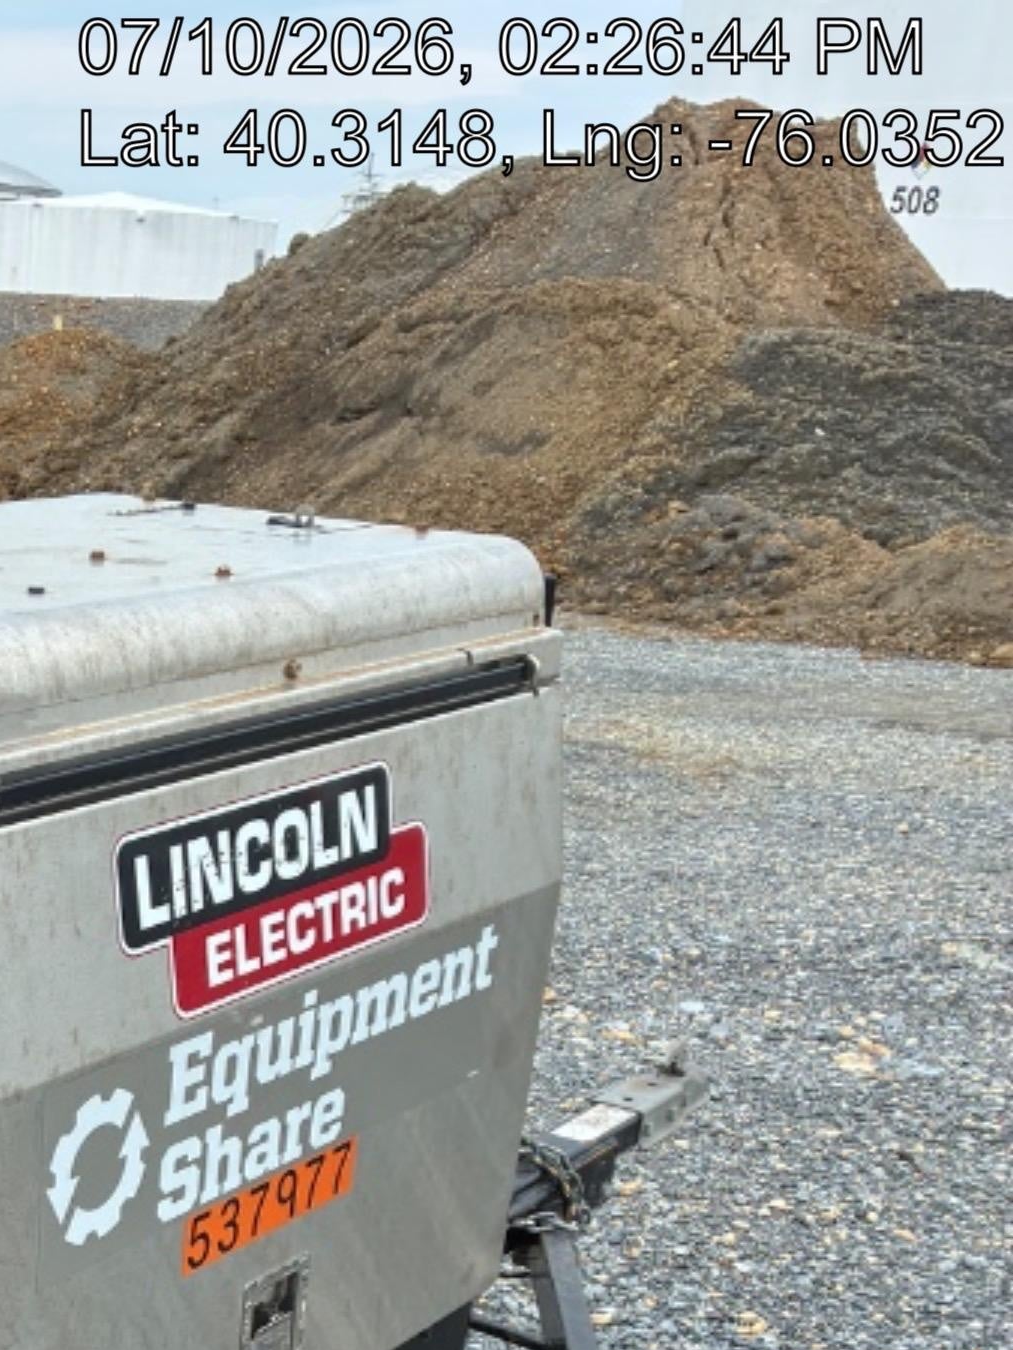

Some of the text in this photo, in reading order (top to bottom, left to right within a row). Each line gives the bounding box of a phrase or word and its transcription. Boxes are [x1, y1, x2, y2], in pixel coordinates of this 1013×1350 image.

[890, 185, 941, 215] 508
[134, 785, 379, 931] LINCOLN
[206, 867, 406, 988] ELECTRIC
[164, 924, 499, 1128] Equipment
[158, 1088, 346, 1222] Share
[188, 1142, 352, 1269] 537977
